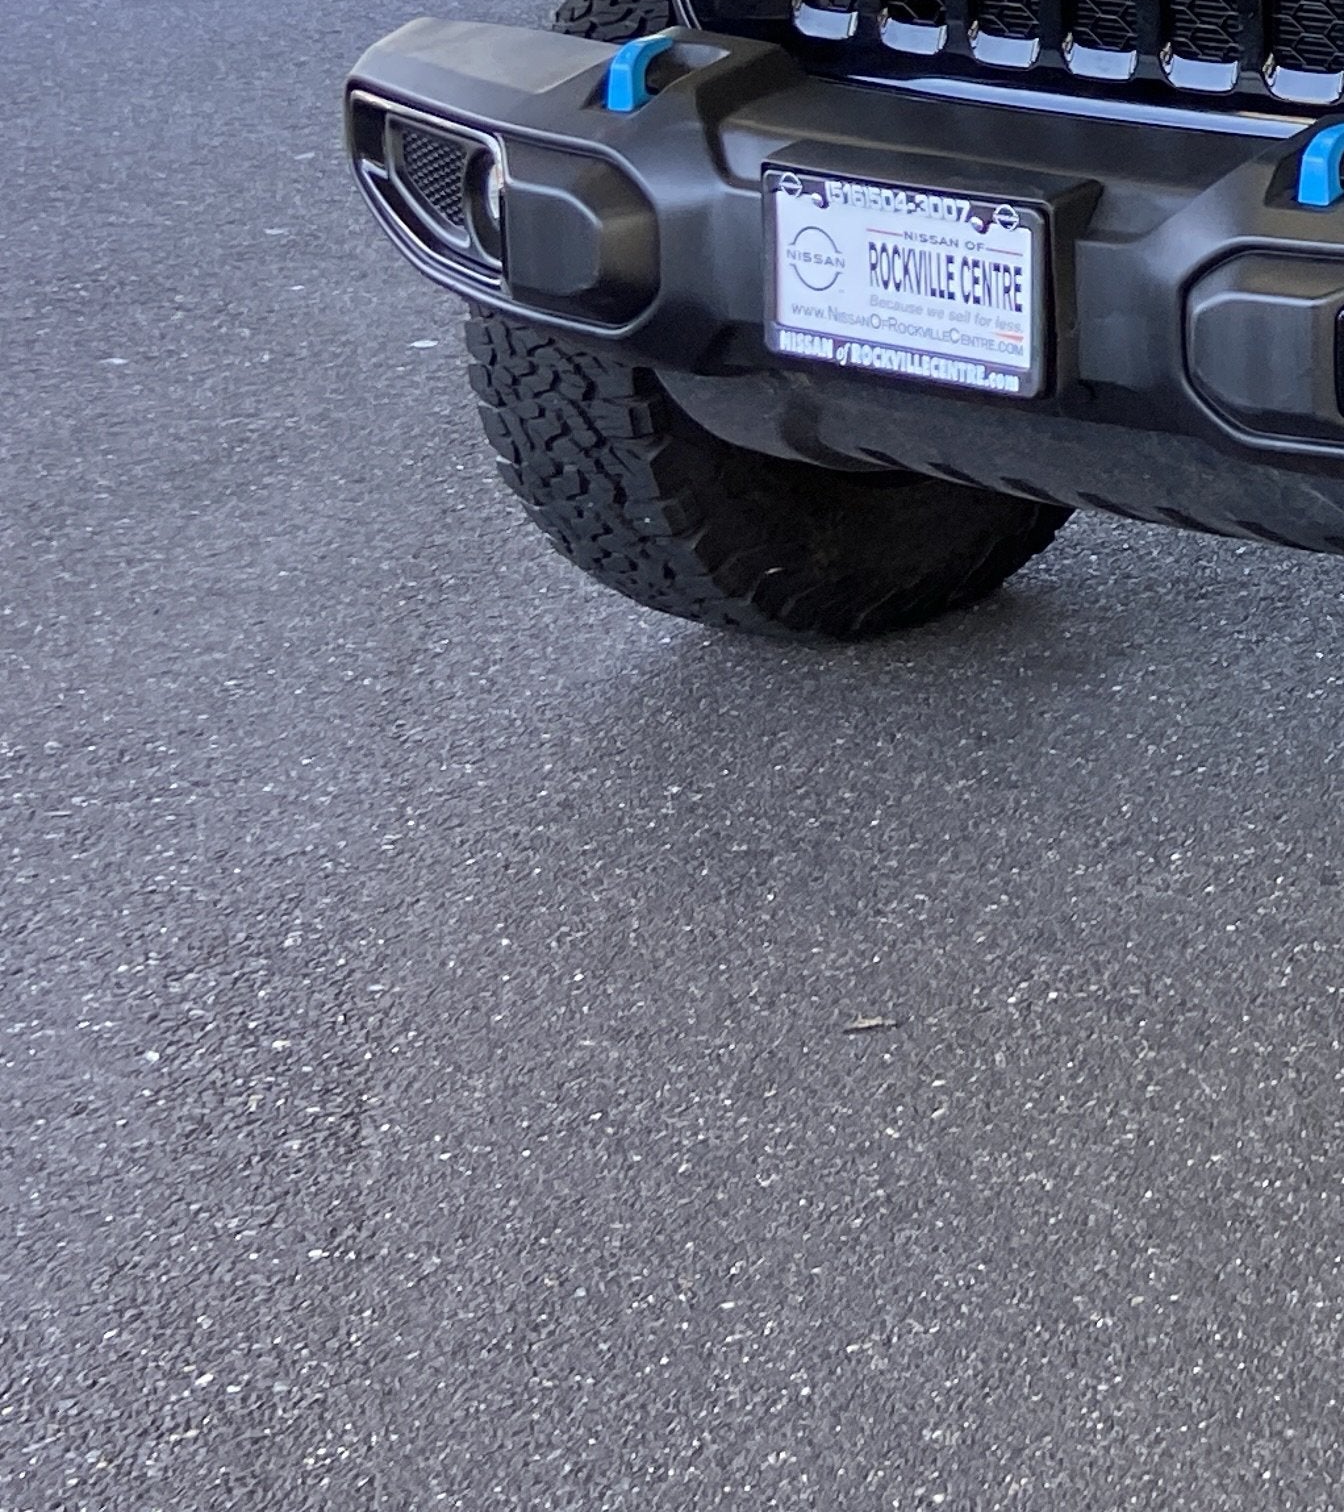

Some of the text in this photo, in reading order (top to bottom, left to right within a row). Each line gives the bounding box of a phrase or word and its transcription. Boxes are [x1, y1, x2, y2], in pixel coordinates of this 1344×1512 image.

[904, 230, 986, 252] NISSAN OF
[786, 249, 846, 268] NISSAN
[868, 241, 1023, 313] ROCKVILLE CENTRE
[869, 294, 924, 315] Because
[926, 305, 945, 320] we
[948, 308, 971, 324] sell
[974, 313, 992, 328] for
[779, 329, 834, 359] NISSAN
